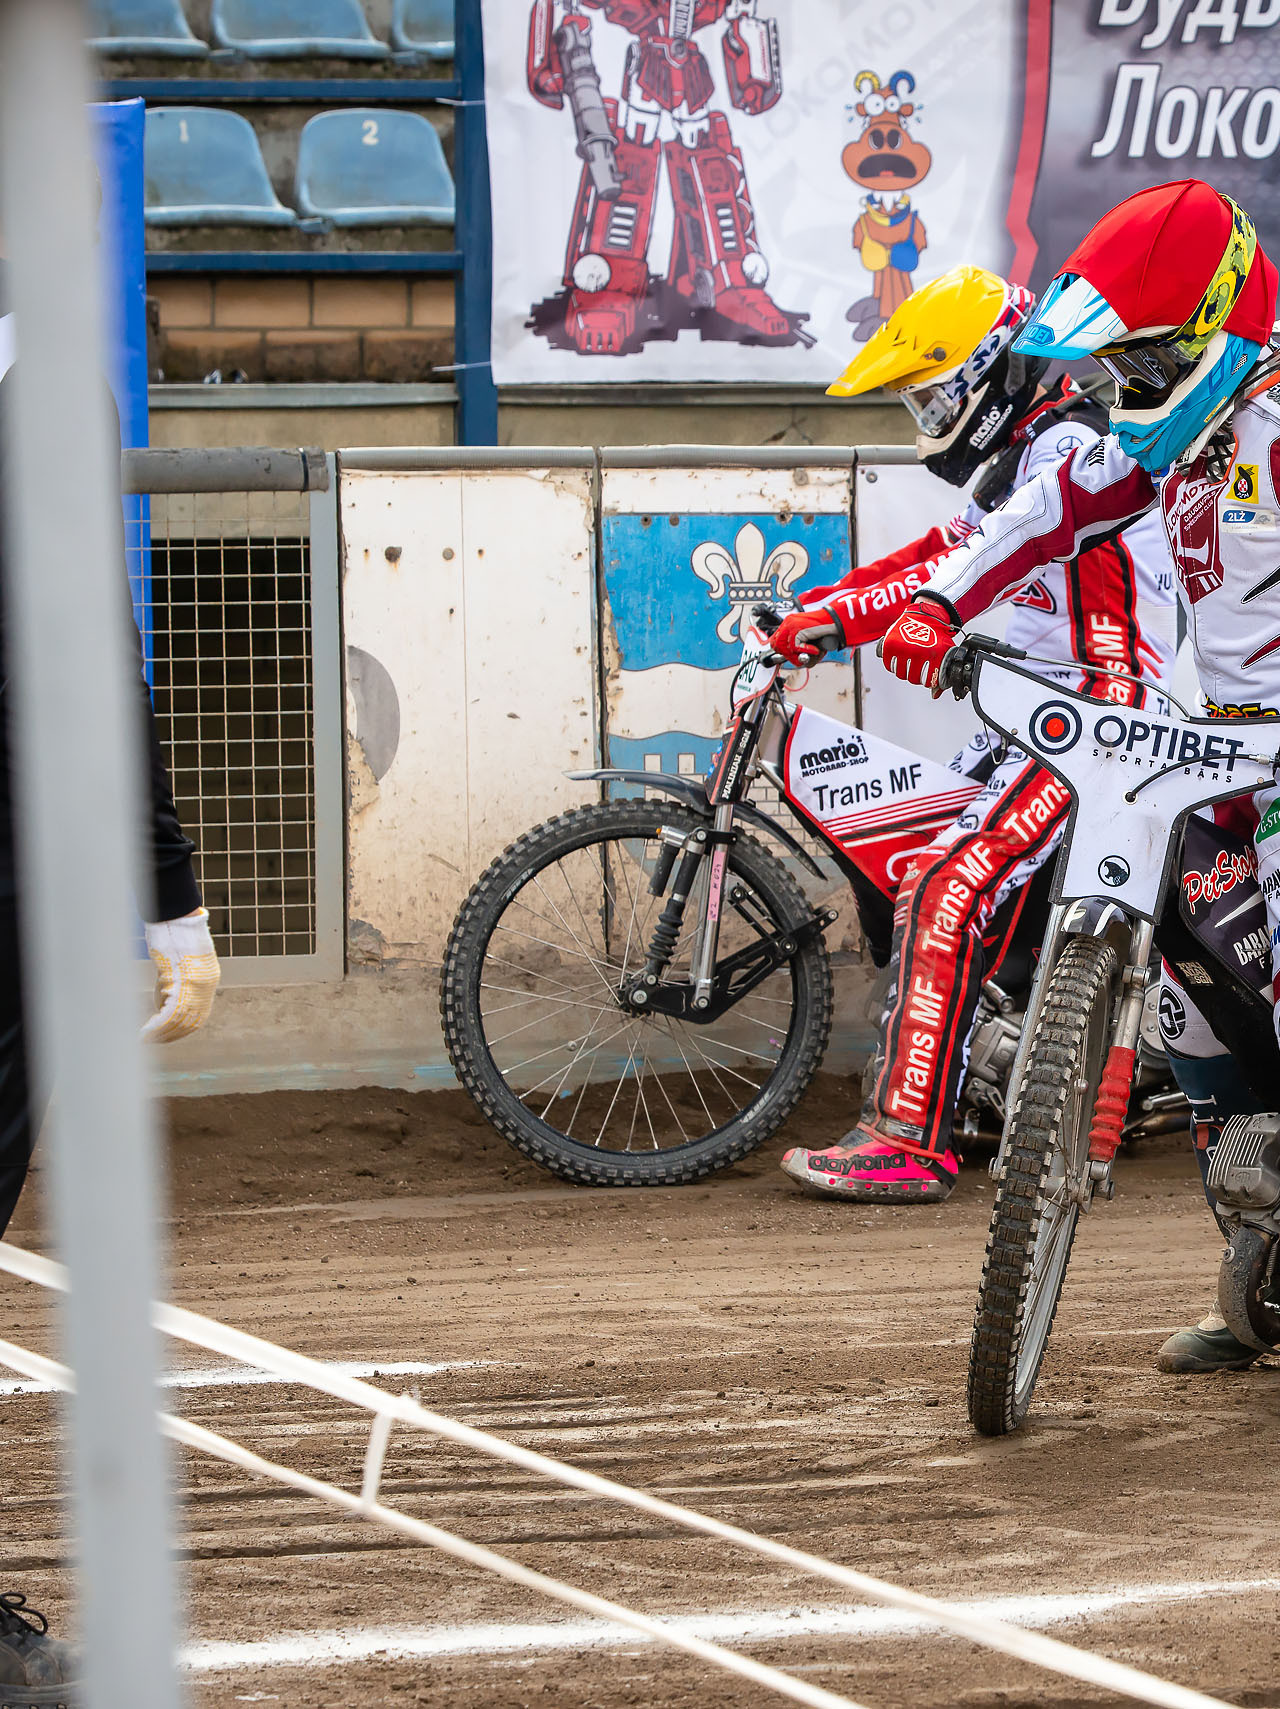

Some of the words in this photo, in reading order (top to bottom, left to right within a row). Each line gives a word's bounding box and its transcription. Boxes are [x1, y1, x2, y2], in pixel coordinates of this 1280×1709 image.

[178, 120, 190, 144] 1
[361, 120, 380, 146] 2
[838, 572, 923, 620] Trans
[1090, 614, 1125, 657] MF
[1092, 748, 1168, 771] SPORTA
[1183, 767, 1233, 784] BĀRS
[1093, 714, 1244, 772] OPTIBET
[813, 778, 883, 811] Trans
[889, 763, 922, 794] MF
[1003, 777, 1072, 842] Trans
[921, 878, 970, 953] Trans
[955, 840, 994, 887] MF
[1183, 844, 1259, 915] PitStop
[908, 975, 945, 1027] MF
[890, 1030, 935, 1112] Trans
[808, 1153, 907, 1176] daytona
